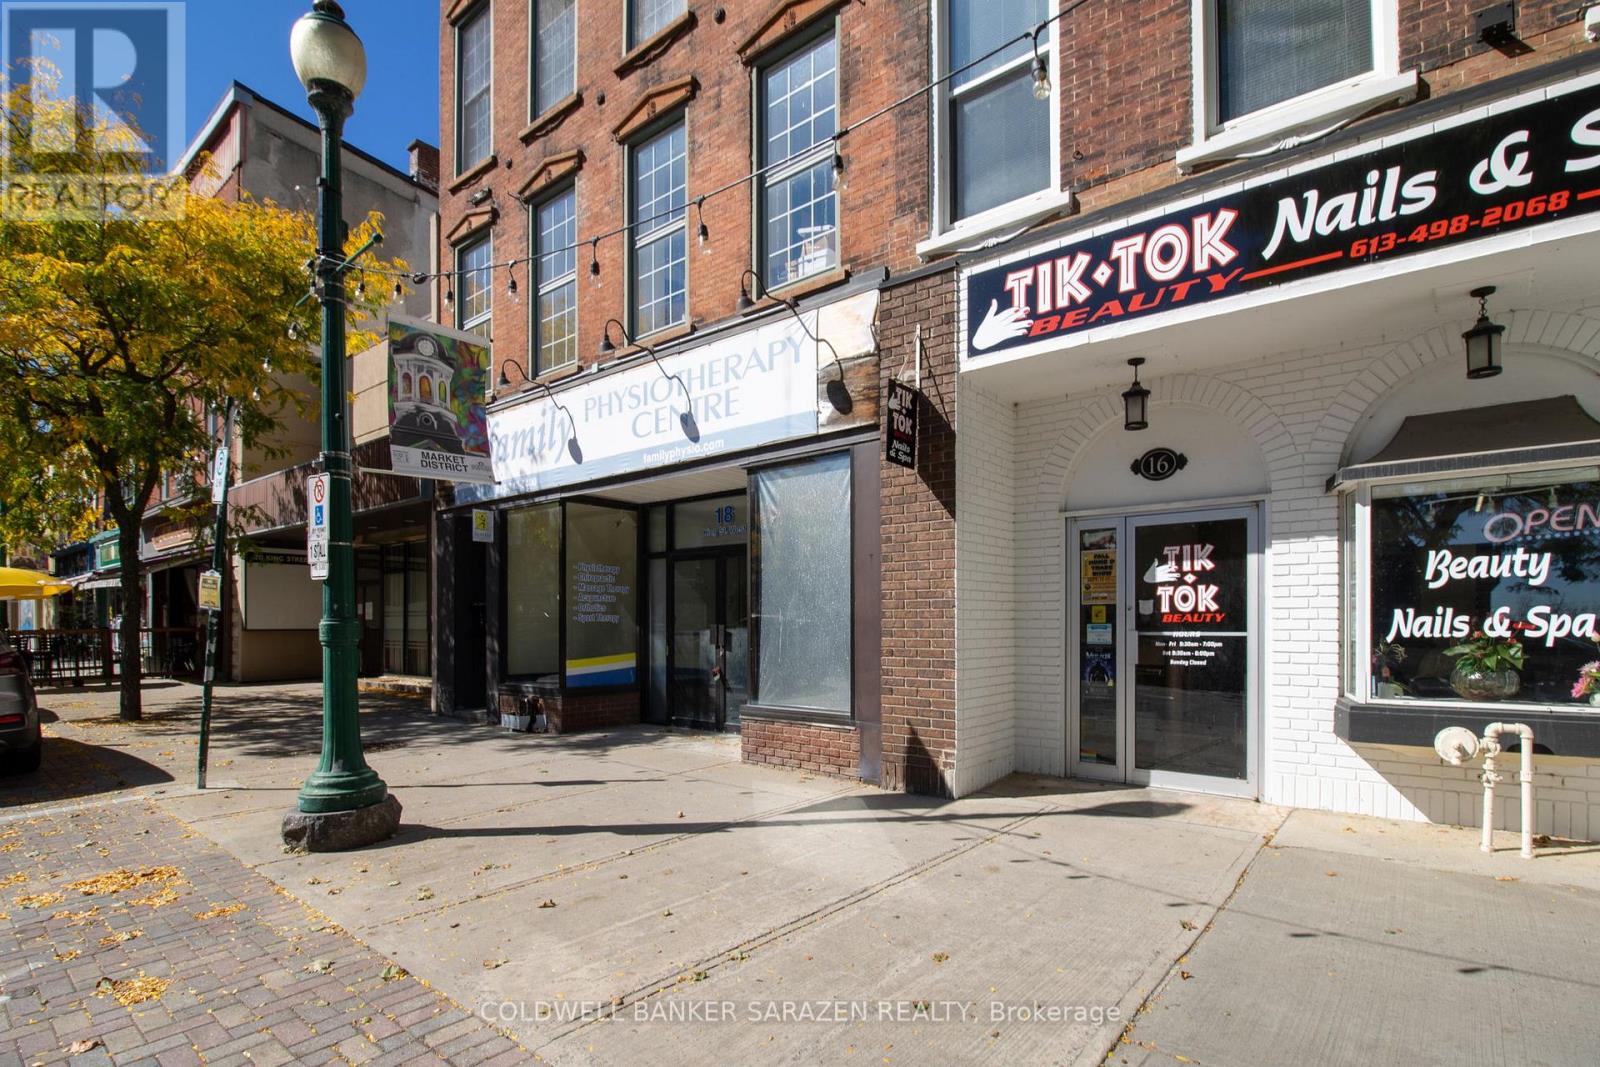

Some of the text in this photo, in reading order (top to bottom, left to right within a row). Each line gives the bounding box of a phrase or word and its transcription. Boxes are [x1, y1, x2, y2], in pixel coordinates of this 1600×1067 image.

[1261, 165, 1437, 261] Nails
[1469, 130, 1533, 195] &
[1350, 190, 1570, 258] 613-498-2068
[1004, 207, 1240, 316] TIK TOK
[1028, 267, 1245, 337] BEAUTY
[584, 333, 807, 422] PHYSIOTHERAPY
[632, 387, 740, 438] CENTRE
[892, 411, 912, 435] TOK
[420, 451, 465, 464] MARKET
[643, 439, 725, 465] familyphysio.com
[891, 439, 911, 453] Nails
[897, 451, 912, 463] Spa
[420, 460, 469, 472] DISTRICT
[1149, 456, 1169, 474] 16
[714, 504, 734, 524] 18
[1483, 503, 1600, 543] OPEN
[1163, 543, 1215, 572] TIK
[1425, 547, 1551, 589] Beauty
[1156, 584, 1219, 613] TOK
[1162, 613, 1225, 623] BEAUTY
[1386, 605, 1596, 647] Nails & Spa
